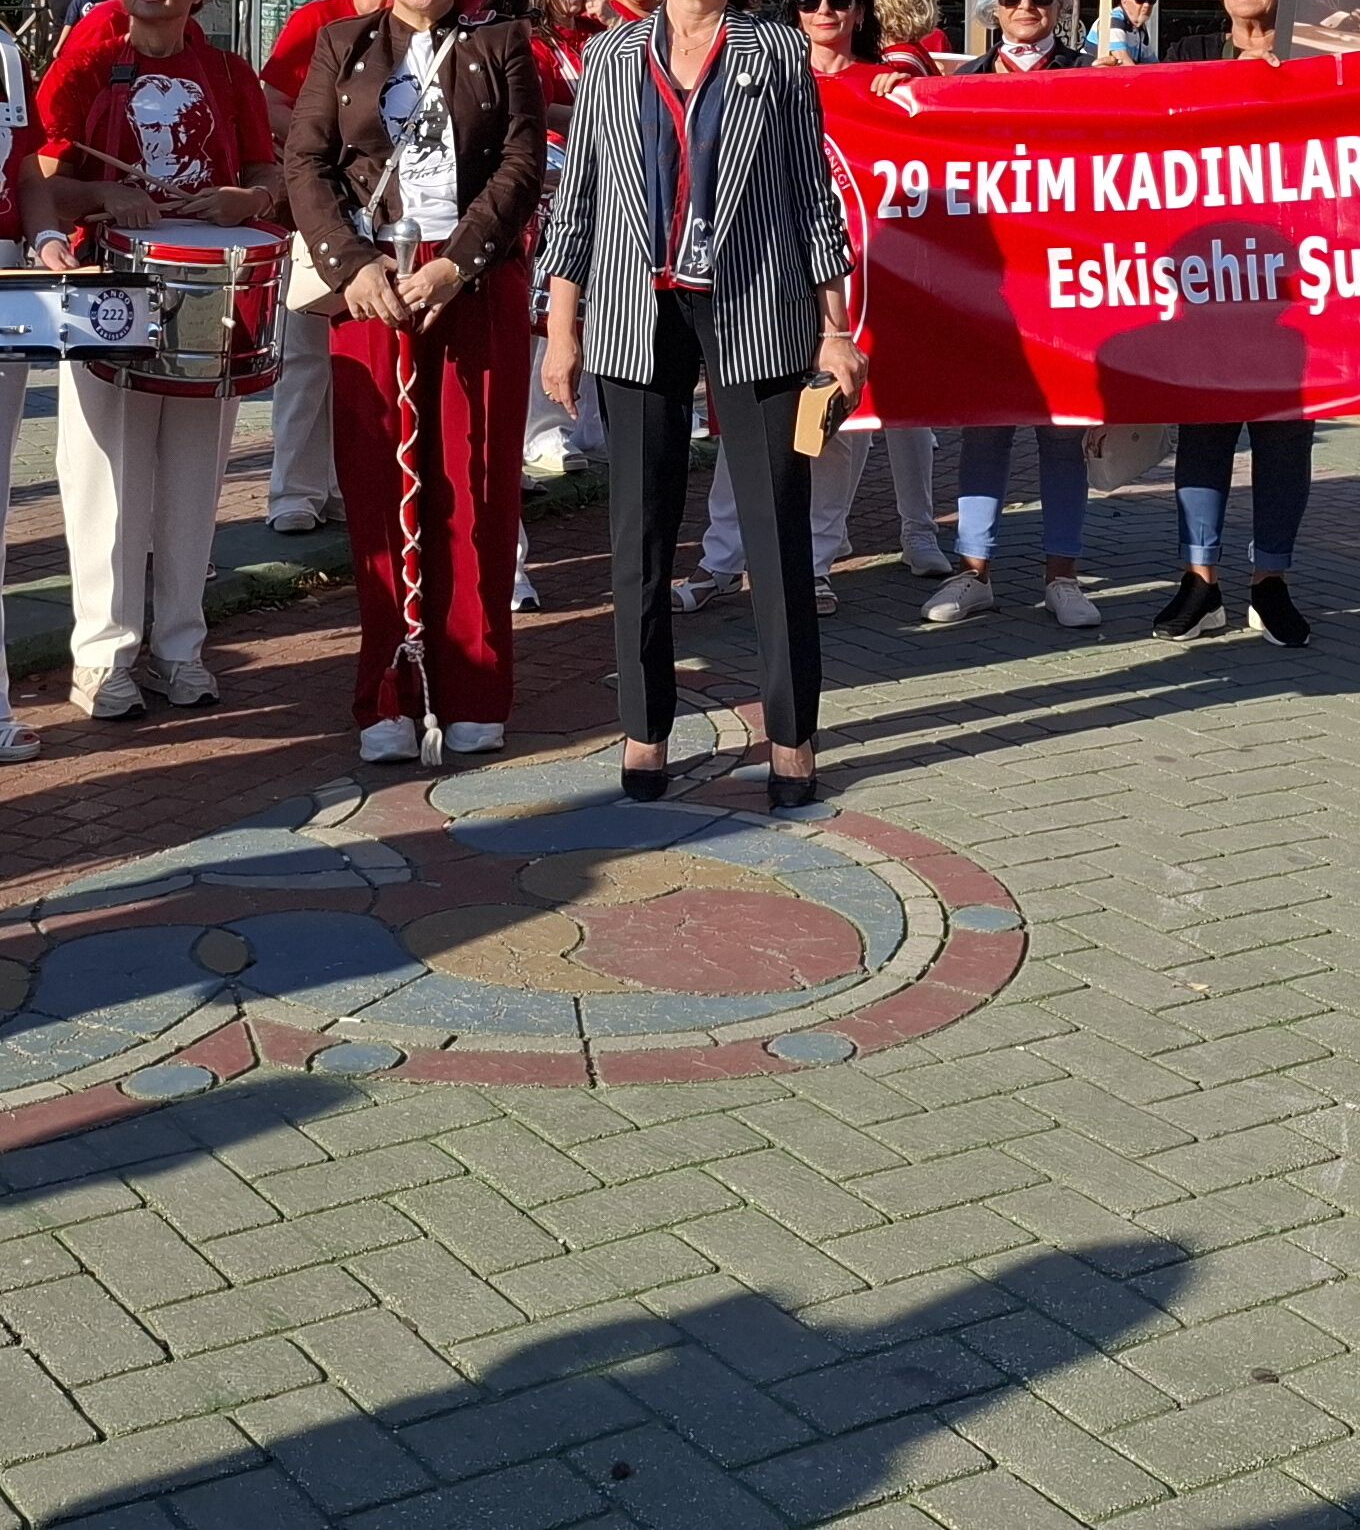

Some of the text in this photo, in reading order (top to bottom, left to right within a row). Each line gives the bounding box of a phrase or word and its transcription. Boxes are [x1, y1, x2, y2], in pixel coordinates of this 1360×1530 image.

[873, 160, 930, 219] 29
[945, 143, 1076, 216] EKİM
[102, 308, 124, 320] 222
[1047, 238, 1285, 321] Eskişehir
